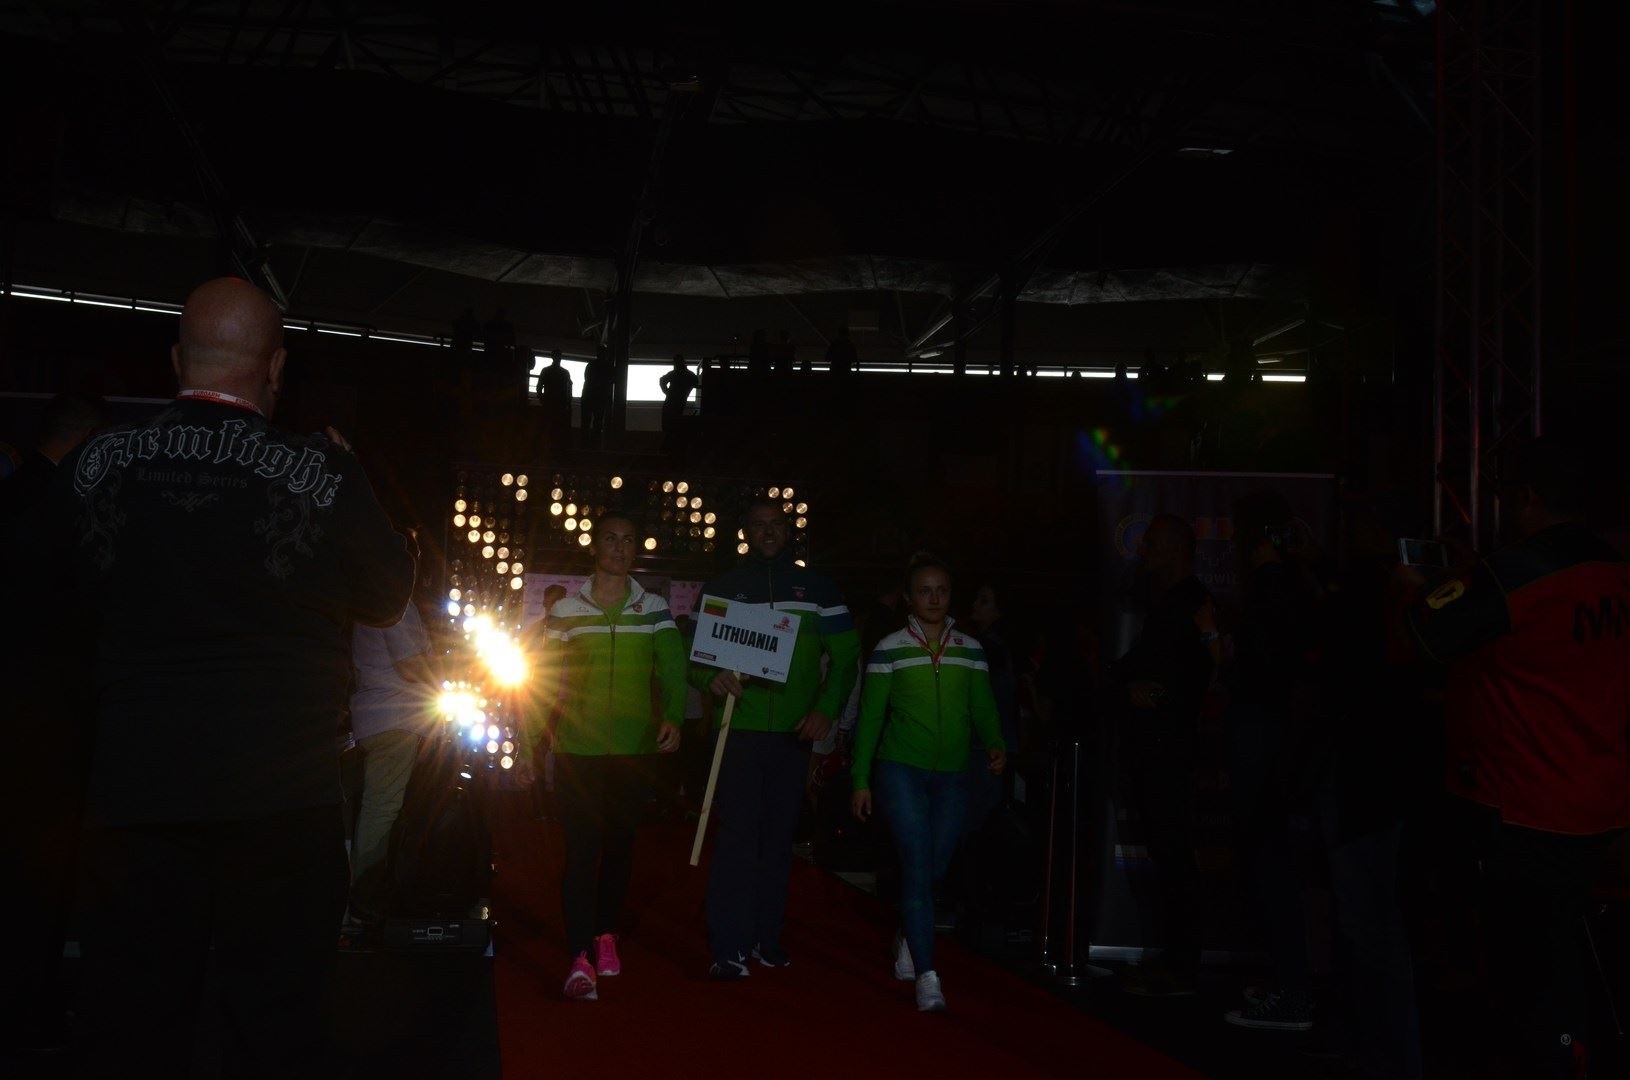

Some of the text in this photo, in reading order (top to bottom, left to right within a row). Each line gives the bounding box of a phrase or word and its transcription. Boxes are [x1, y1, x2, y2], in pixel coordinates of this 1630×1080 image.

[135, 466, 249, 489] Limited Series
[711, 622, 779, 653] LITHUANIA
